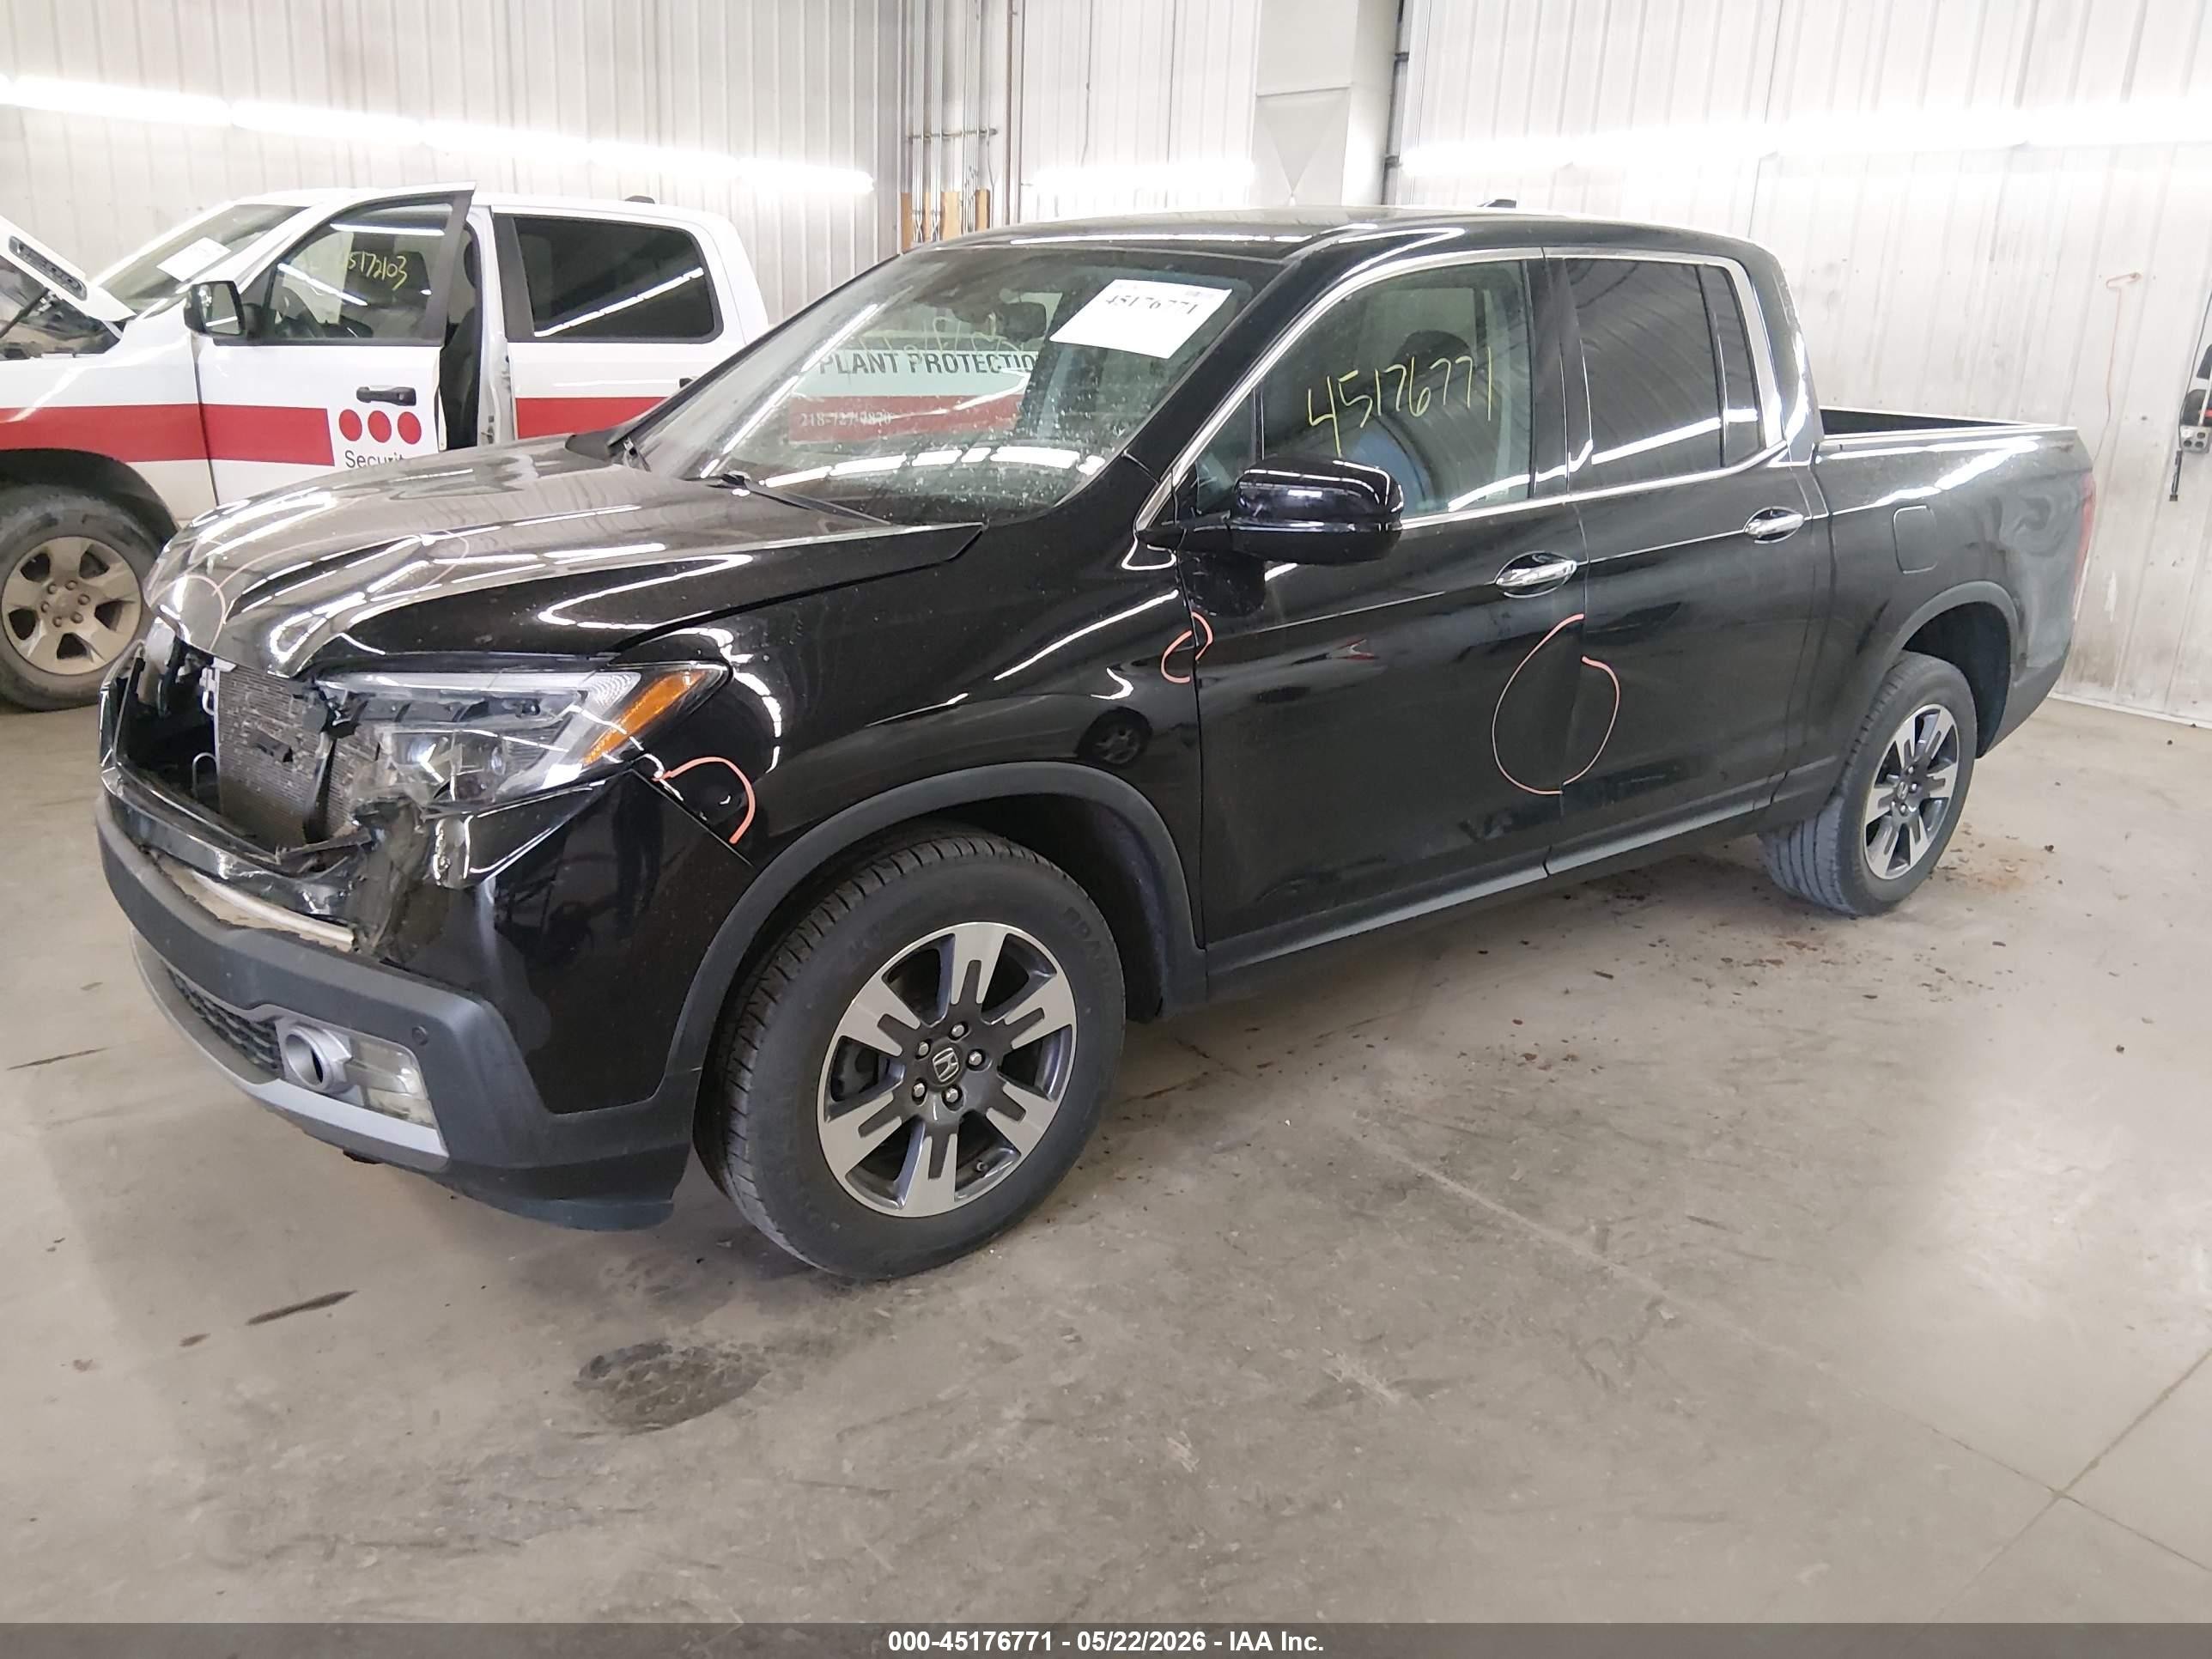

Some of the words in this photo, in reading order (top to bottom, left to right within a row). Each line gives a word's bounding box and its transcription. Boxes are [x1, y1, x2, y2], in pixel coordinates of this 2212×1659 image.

[343, 249, 408, 291] 5172103
[819, 352, 900, 374] PLANT
[909, 352, 1037, 374] PROTECTIO
[1307, 346, 1492, 459] 45176771
